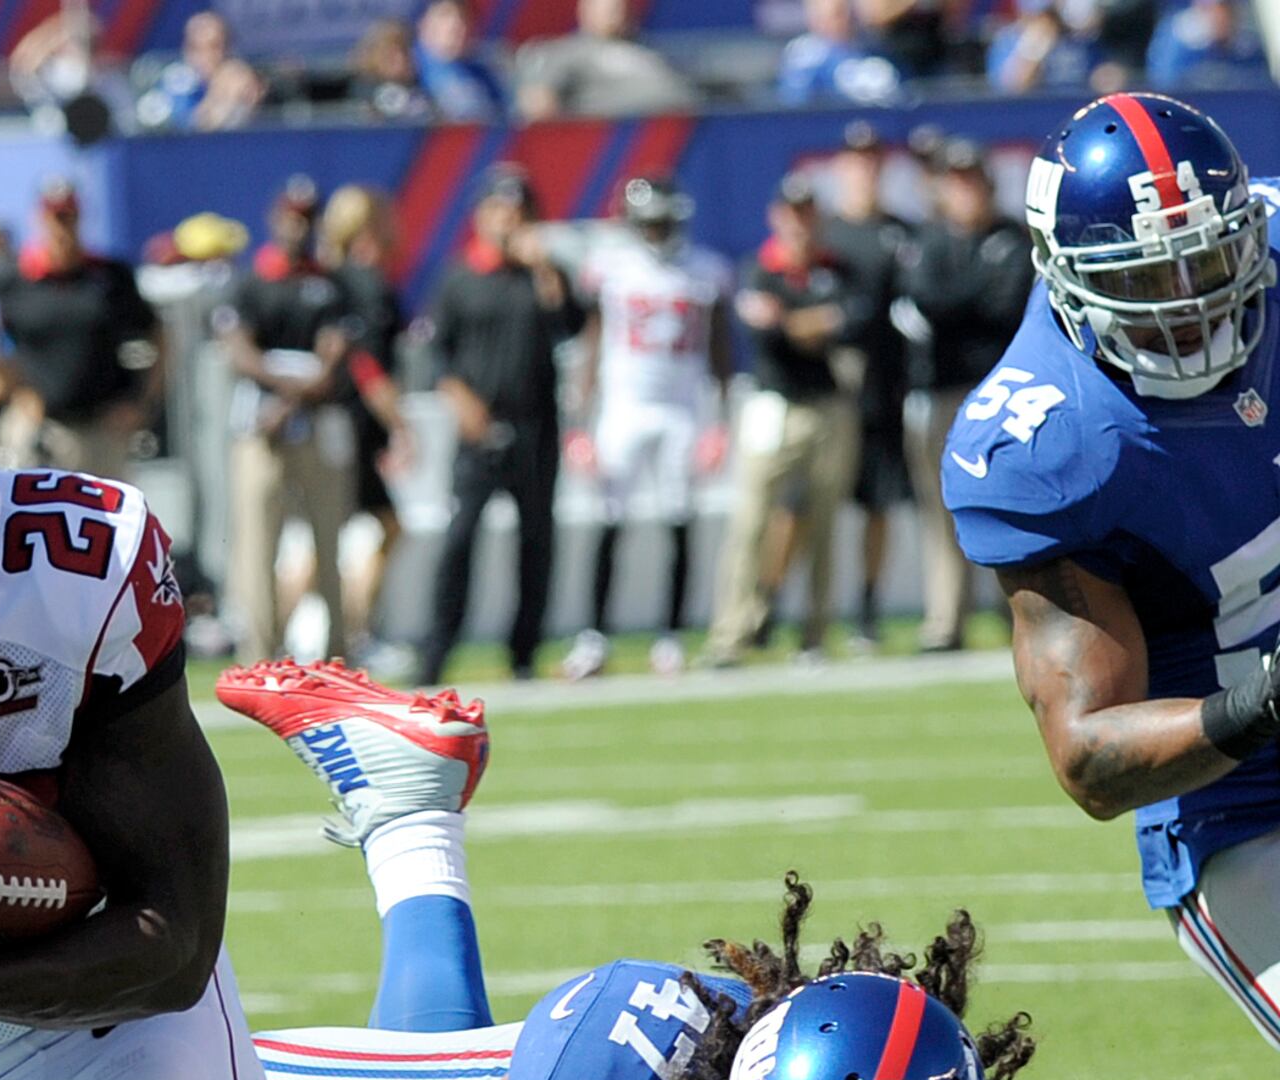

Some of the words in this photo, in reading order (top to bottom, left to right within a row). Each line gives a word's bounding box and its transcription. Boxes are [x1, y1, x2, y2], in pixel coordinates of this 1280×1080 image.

[1127, 160, 1204, 213] 54
[965, 366, 1066, 444] 54
[2, 473, 125, 580] 26
[301, 723, 369, 794] NIKE
